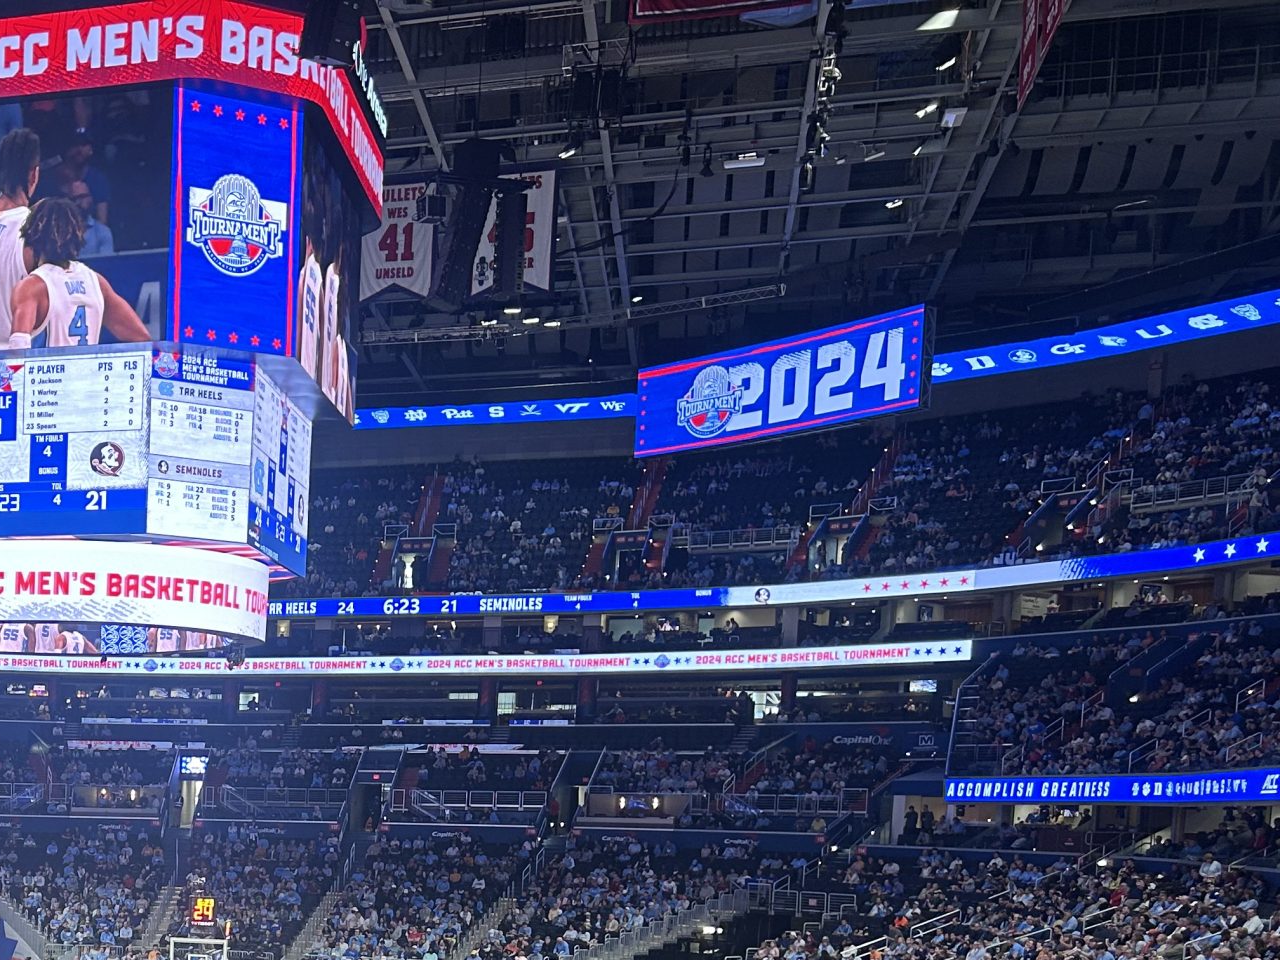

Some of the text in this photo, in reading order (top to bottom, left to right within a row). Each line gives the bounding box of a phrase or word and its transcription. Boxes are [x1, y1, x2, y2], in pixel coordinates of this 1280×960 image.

[66, 15, 205, 69] MEN'S
[382, 186, 424, 202] ULLETS
[228, 199, 246, 209] ACC
[387, 207, 408, 220] WES
[193, 210, 279, 251] TOURNAMENT
[379, 222, 415, 262] 41
[375, 266, 415, 280] UNSELD
[65, 280, 86, 296] DAVIS
[68, 305, 89, 347] 4
[37, 361, 138, 375] PLAYER PTS FLS
[182, 356, 218, 368] 2024 ACC
[37, 377, 62, 385] Jackson
[182, 372, 228, 386] TOURNAMENT
[204, 366, 249, 381] BASKETBALL
[725, 326, 907, 433] 2024
[179, 386, 223, 401] TAR HEELS
[677, 387, 744, 425] TOURNAMENT
[235, 412, 243, 420] 12
[36, 422, 57, 431] Spears
[35, 434, 63, 443] TM FOULS
[43, 445, 52, 457] 4
[175, 464, 222, 479] SEMINOLES
[53, 494, 62, 506] 4
[85, 491, 108, 510] 21
[15, 571, 96, 596] MEN'S
[107, 573, 240, 609] BASKETBALL
[286, 597, 543, 615] HEELS 24 6:23 21 SEMINOLES
[12, 658, 63, 668] BASKETBALL
[67, 660, 123, 669] TOURNAMENT
[427, 658, 630, 668] 2024 ACC MEN'S BASKETBALL TOURNAMENT
[696, 648, 910, 664] 2024 ACC MEN'S BASKETBALL TOURNAMENT
[179, 661, 367, 670] 2024 ACC BASKETBALL TOURNAMENT
[947, 780, 1110, 797] ACCOMPLISH GREATNESS
[194, 906, 214, 920] 24
